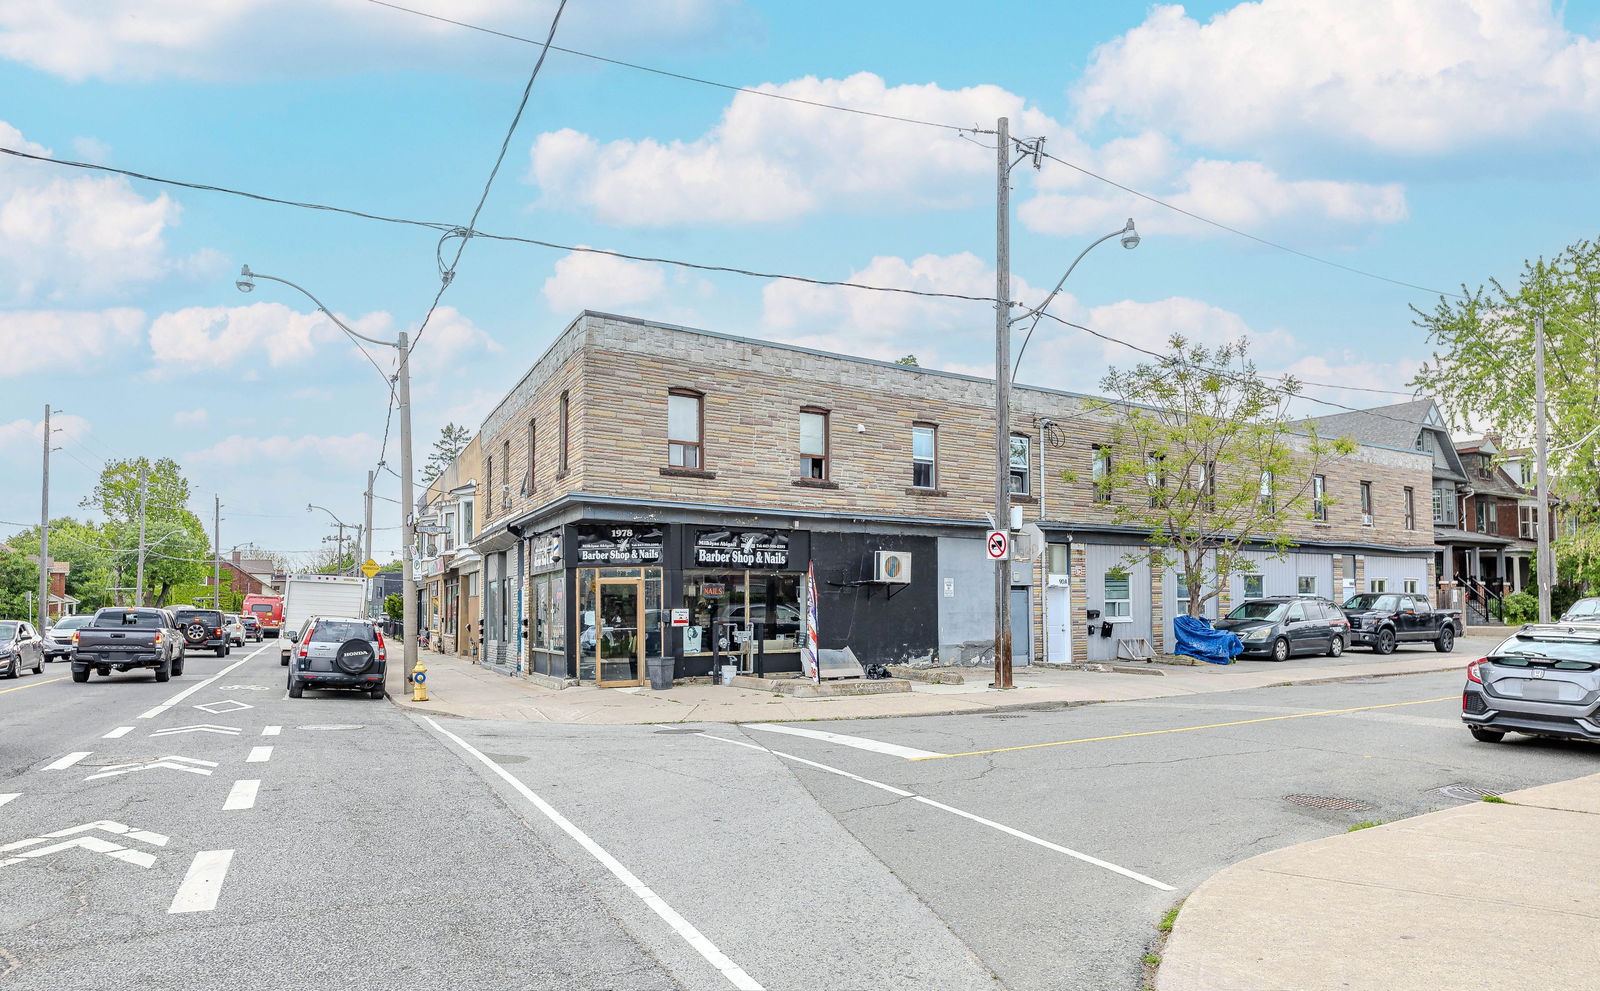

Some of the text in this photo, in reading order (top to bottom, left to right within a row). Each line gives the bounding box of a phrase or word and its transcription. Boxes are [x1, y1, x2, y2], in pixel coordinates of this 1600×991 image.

[611, 529, 633, 537] 1978
[582, 549, 659, 560] Barber Shop & Nails
[698, 549, 786, 565] Barber Shop & Nails
[703, 587, 723, 595] NAILS
